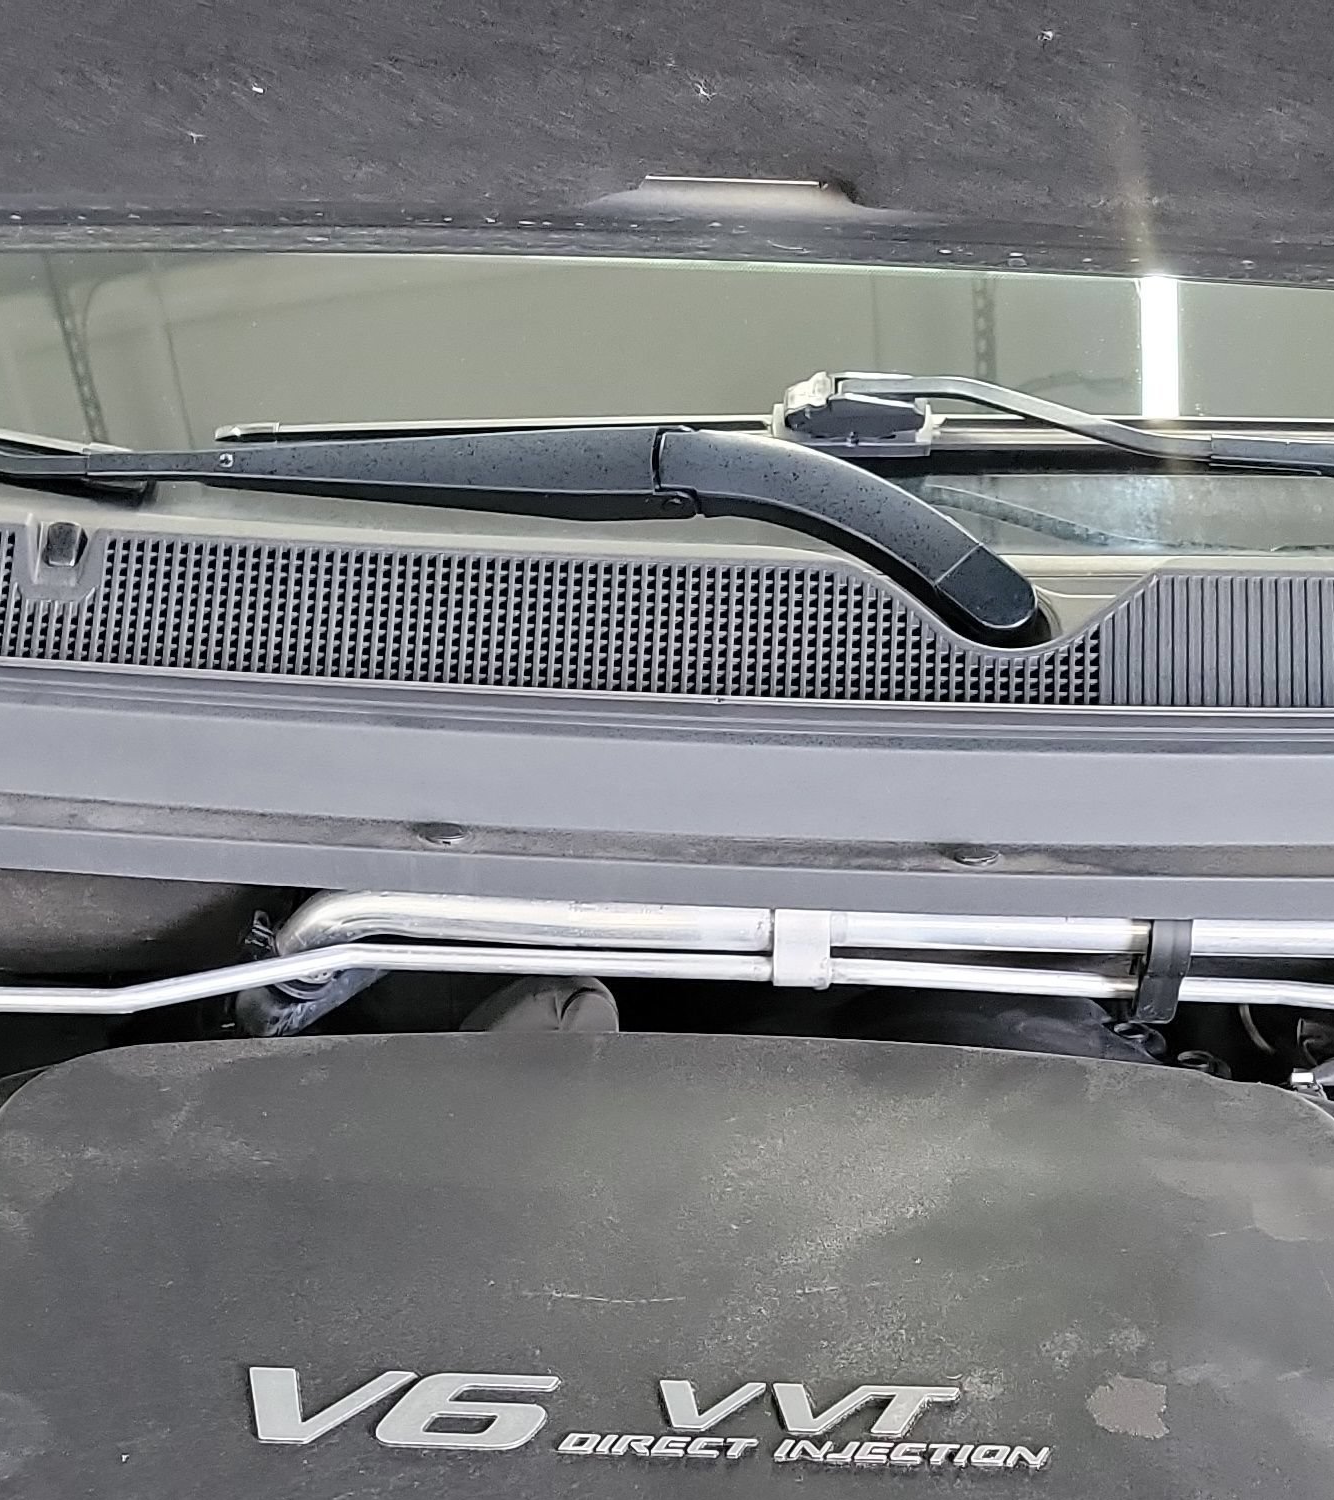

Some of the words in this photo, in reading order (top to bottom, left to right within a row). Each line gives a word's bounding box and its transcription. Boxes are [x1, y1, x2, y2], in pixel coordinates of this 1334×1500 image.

[248, 1366, 562, 1450] V6
[660, 1379, 960, 1438] VVT
[556, 1431, 758, 1458] DIRECT
[772, 1437, 1052, 1470] INJECTION
